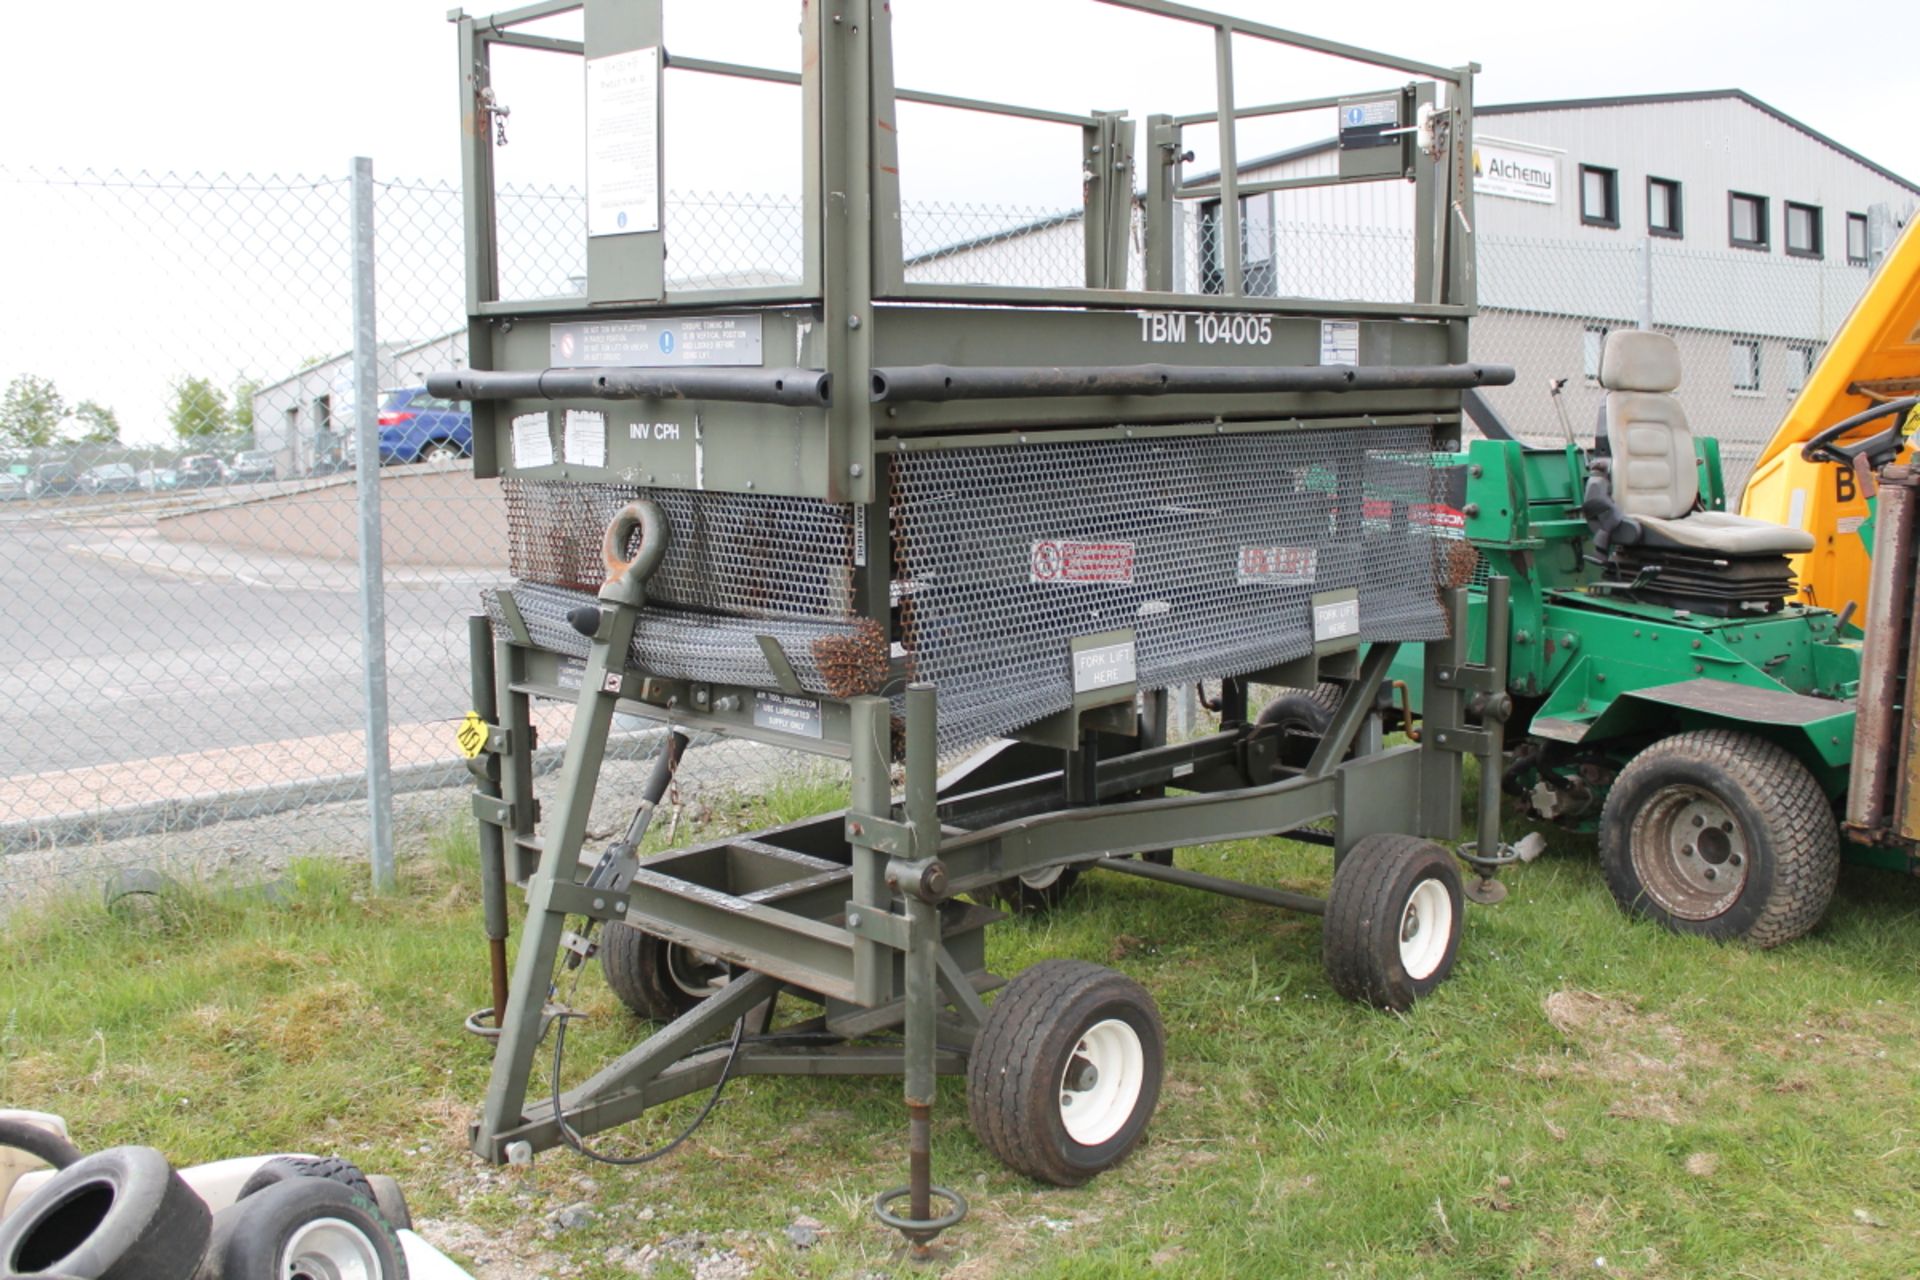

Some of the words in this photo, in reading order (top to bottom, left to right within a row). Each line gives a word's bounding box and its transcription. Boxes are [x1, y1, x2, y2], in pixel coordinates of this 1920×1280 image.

[1488, 158, 1551, 188] Alchemy
[1138, 312, 1185, 343] TBM
[1195, 313, 1272, 345] 104005
[630, 423, 650, 439] INV
[654, 423, 680, 440] CPH
[1340, 606, 1354, 618] LIFT
[1080, 653, 1106, 669] FORK
[1109, 649, 1129, 664] LIFT
[1094, 668, 1119, 684] HERE
[756, 691, 766, 699] AIR
[768, 692, 782, 703] TOOL
[784, 696, 816, 708] CONNECTOR
[768, 716, 788, 727] SUPPLY
[790, 721, 805, 730] ONLY
